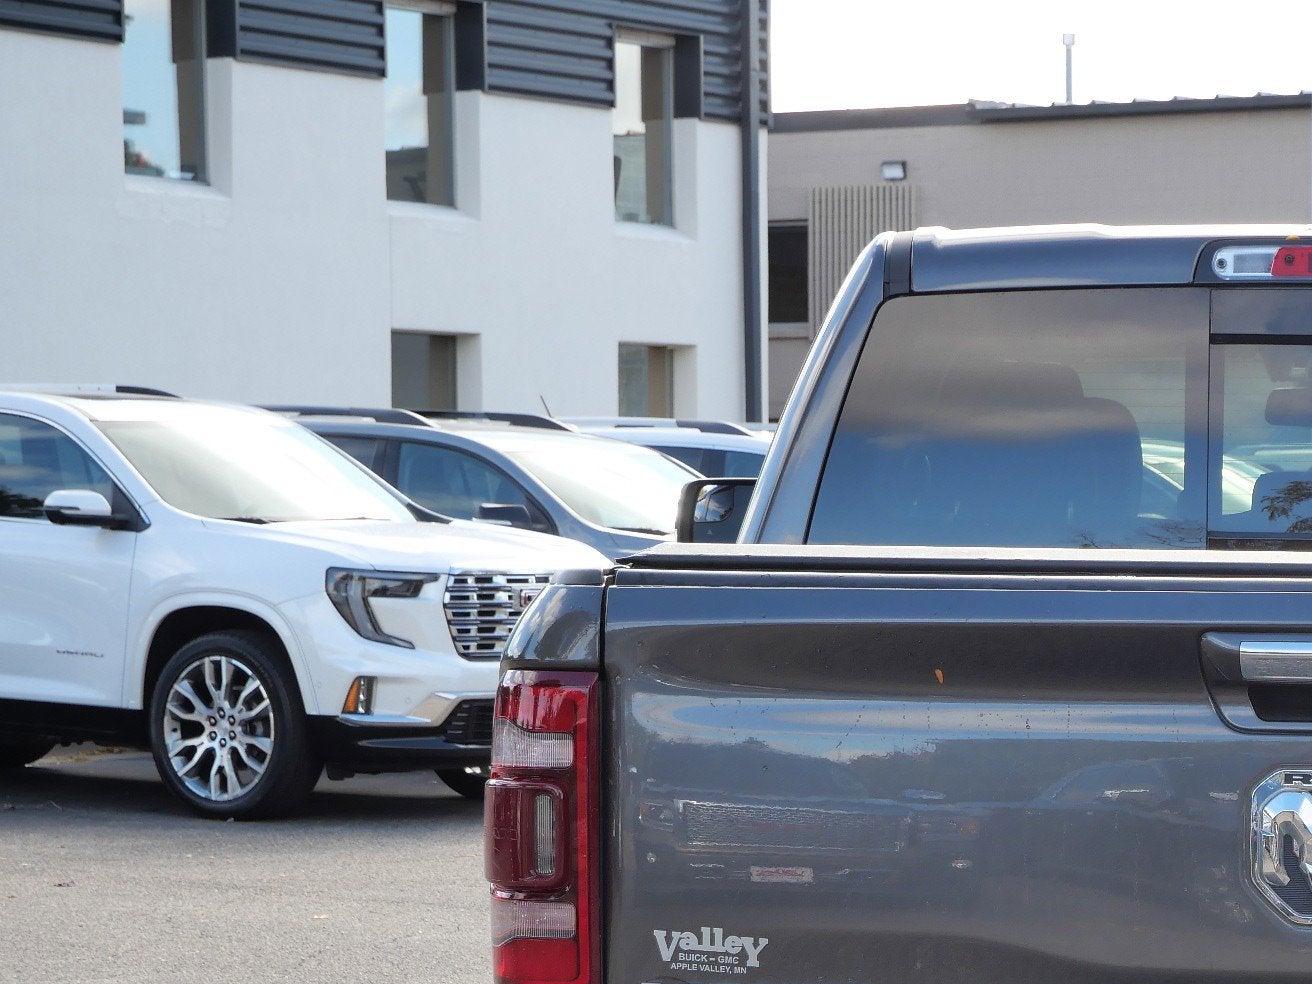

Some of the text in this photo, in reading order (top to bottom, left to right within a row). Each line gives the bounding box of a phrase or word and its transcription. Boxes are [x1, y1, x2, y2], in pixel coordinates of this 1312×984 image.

[654, 926, 769, 968] Valley
[678, 952, 708, 963] BUICK
[717, 954, 739, 964] GMC
[670, 962, 747, 974] APPLE VALLEY, MN
